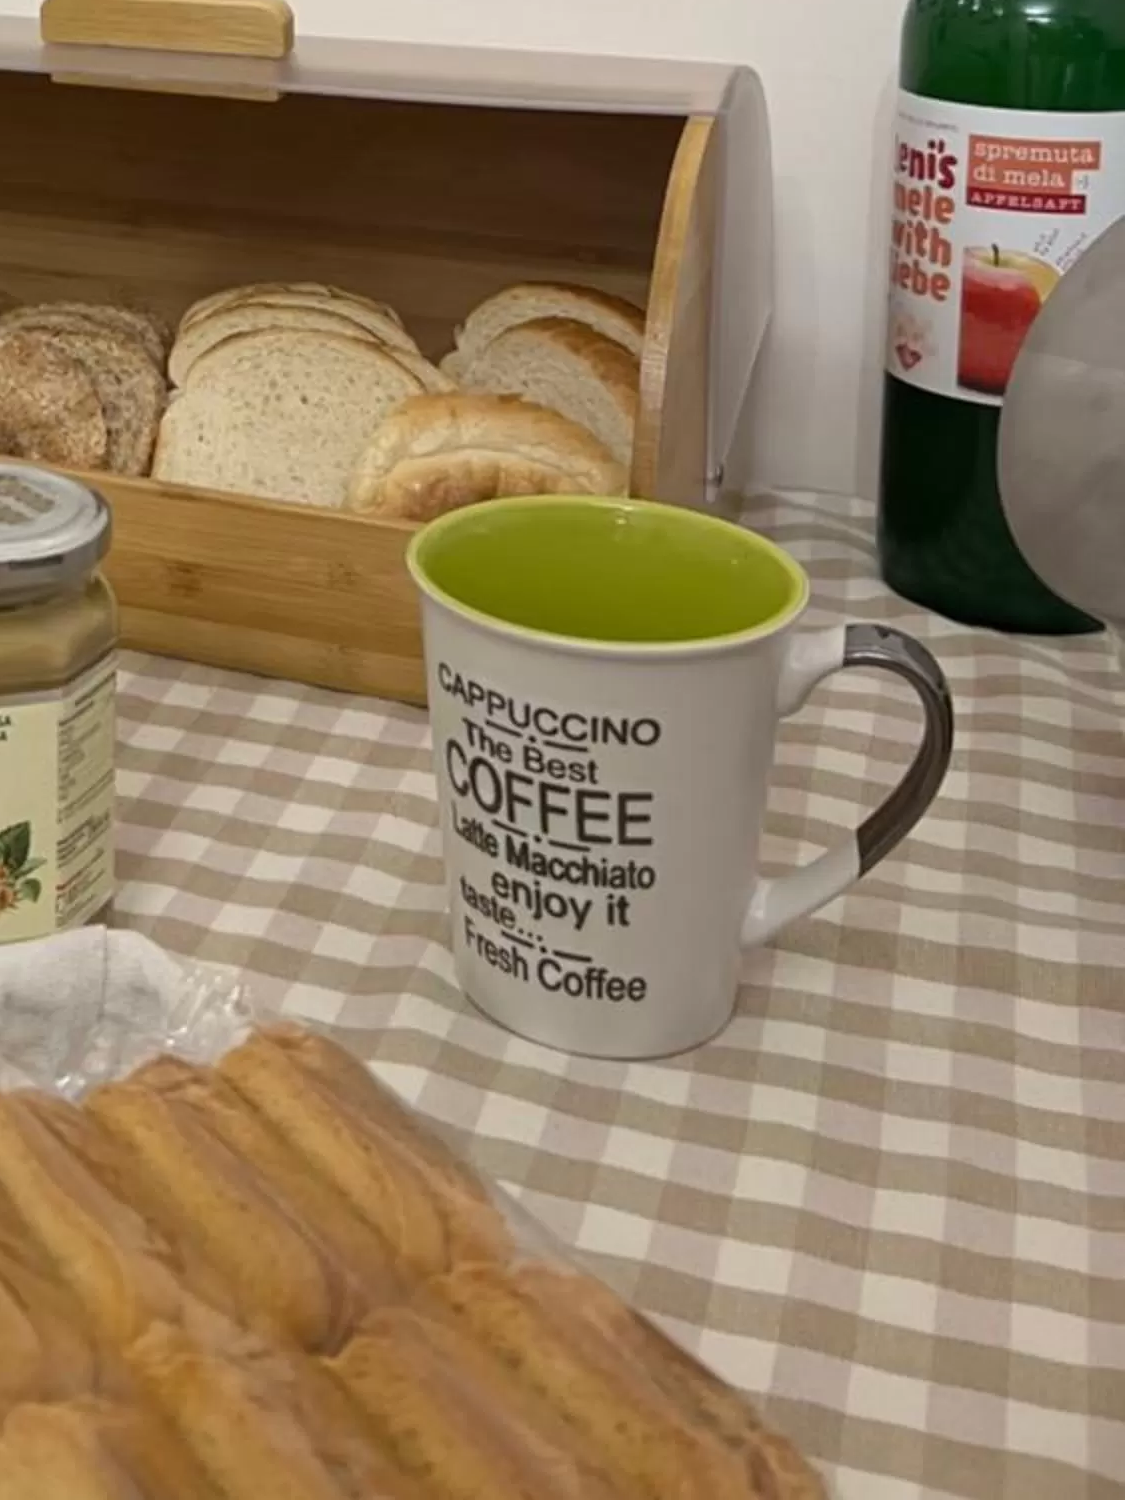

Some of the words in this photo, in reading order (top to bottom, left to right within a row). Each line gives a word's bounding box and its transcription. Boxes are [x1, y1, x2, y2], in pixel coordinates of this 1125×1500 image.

[974, 141, 1095, 164] spremuta
[974, 166, 995, 183] di
[1002, 167, 1065, 189] mela
[971, 192, 1083, 212] APFELSAFT
[438, 662, 661, 747] CAPPUCCINO
[463, 717, 512, 763] The
[523, 744, 598, 785] Best
[446, 738, 654, 846] COFFEE
[451, 800, 500, 857] Latte
[506, 835, 656, 890] Macchiato
[491, 871, 592, 931] enjoy
[606, 893, 630, 927] it
[464, 915, 529, 982] Fresh
[537, 957, 648, 1003] Coffee
